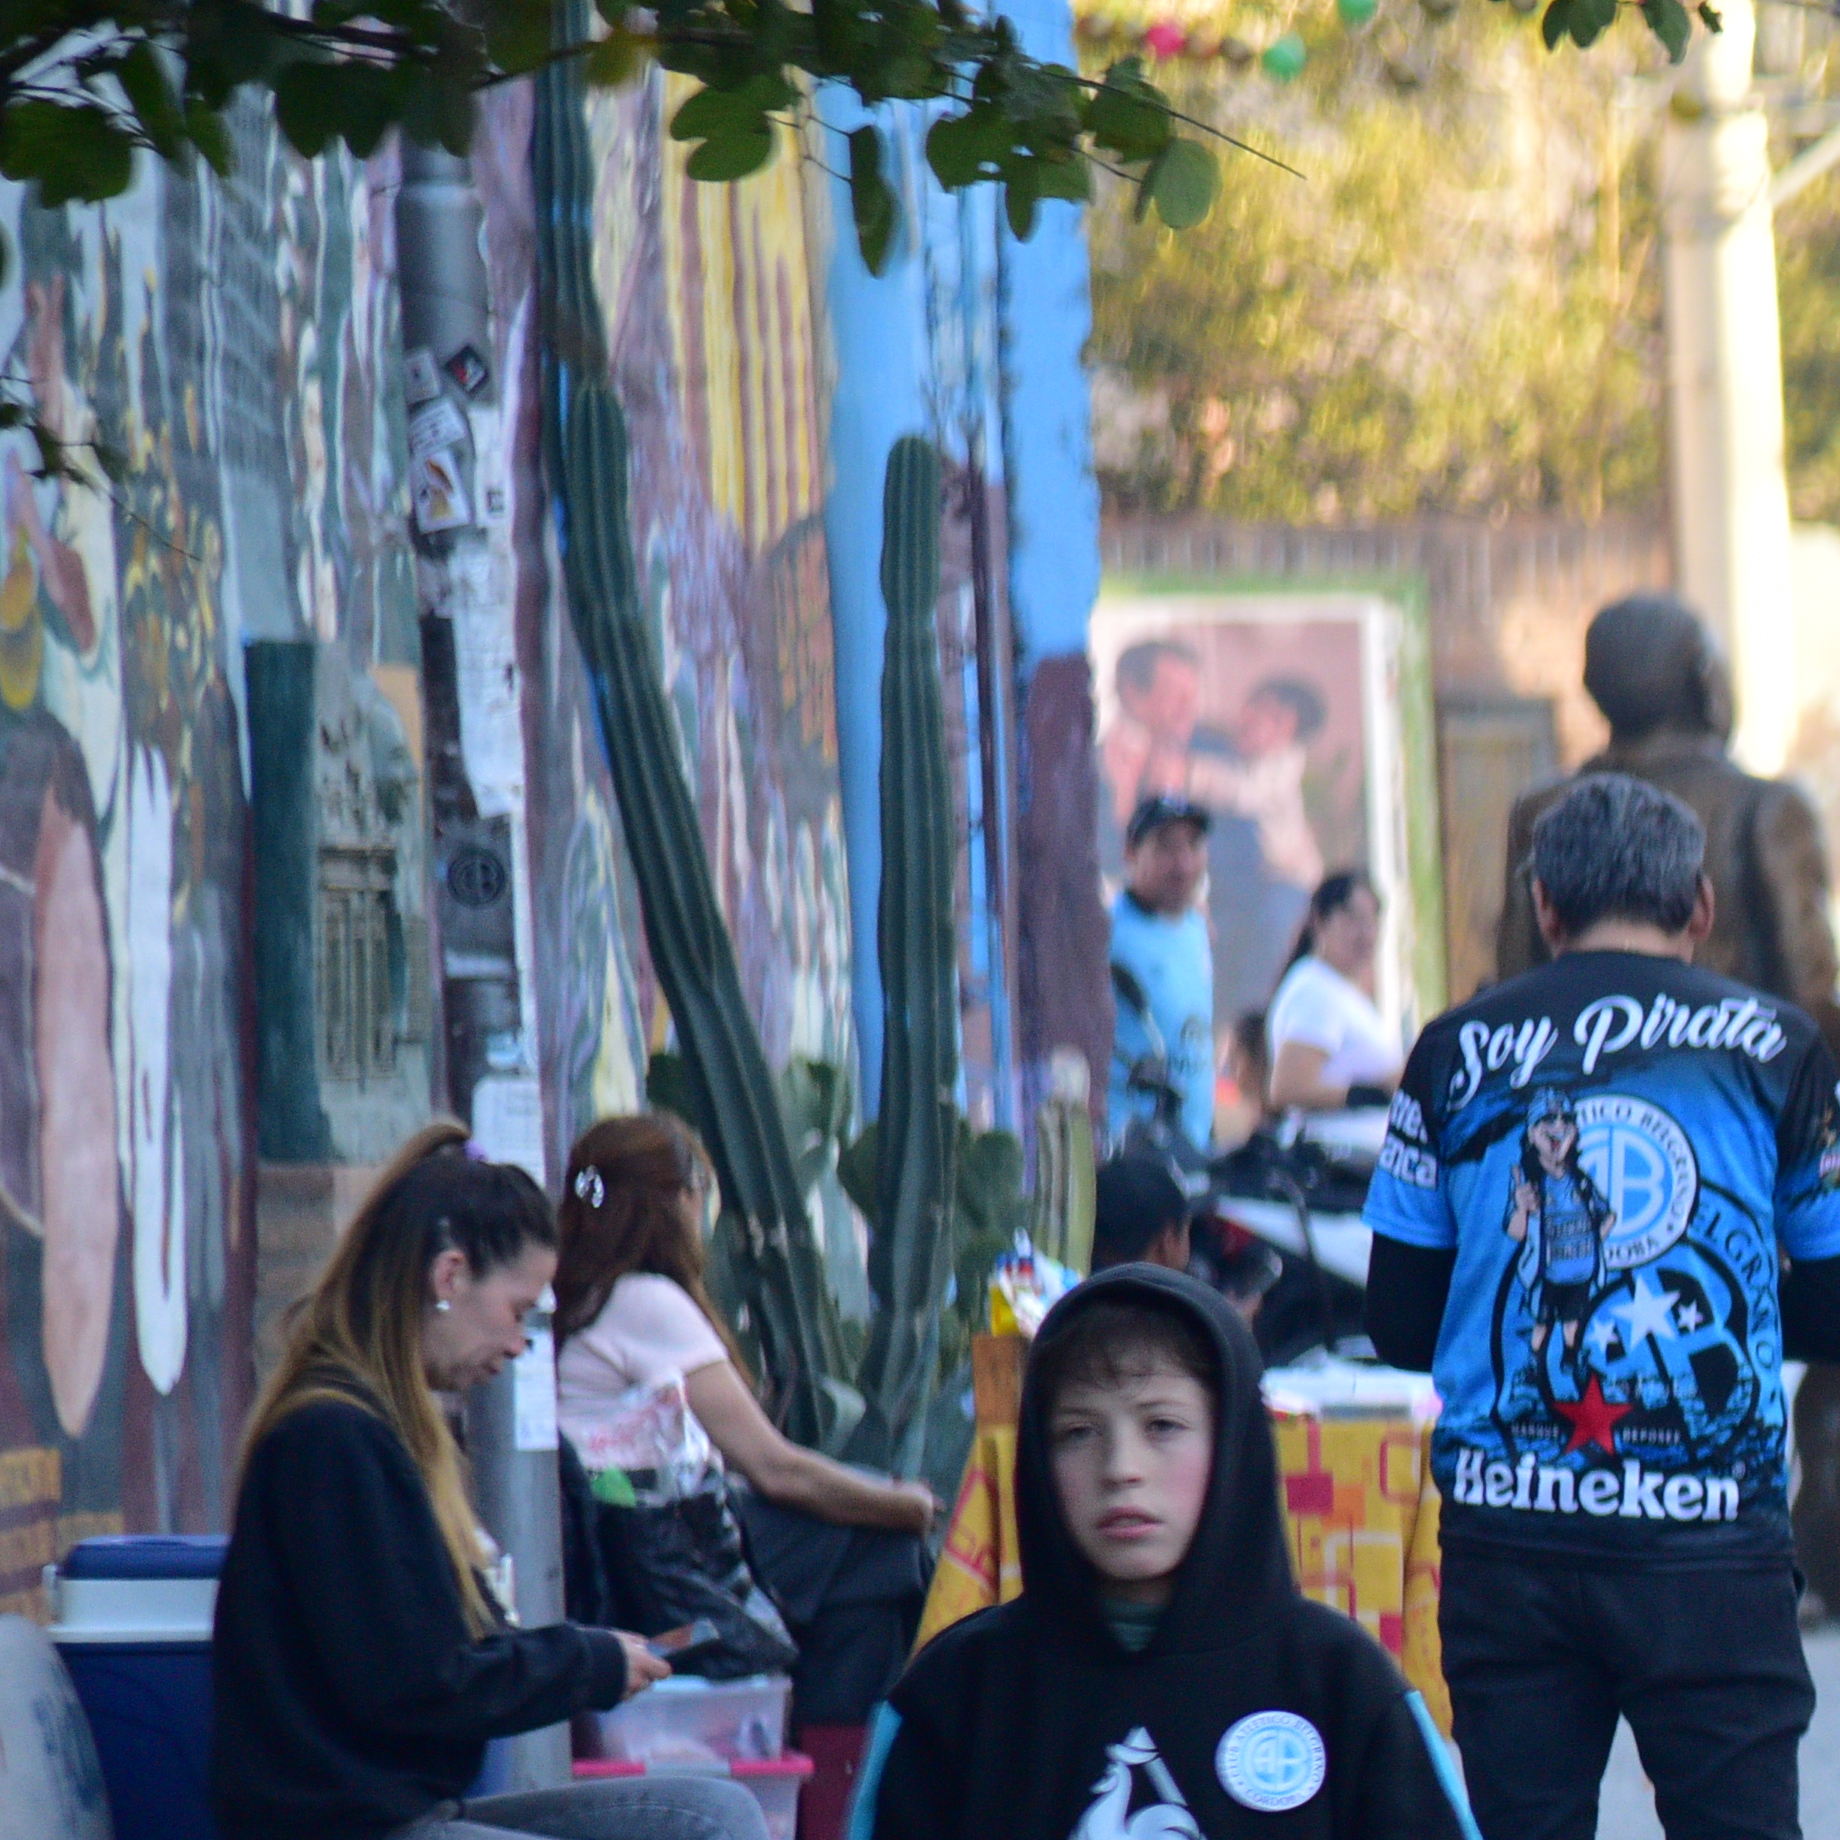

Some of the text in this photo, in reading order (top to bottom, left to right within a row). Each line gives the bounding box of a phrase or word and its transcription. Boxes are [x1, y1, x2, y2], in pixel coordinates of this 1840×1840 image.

[1446, 992, 1788, 1111] Soy Pirata
[1453, 1448, 1740, 1522] Heineken
